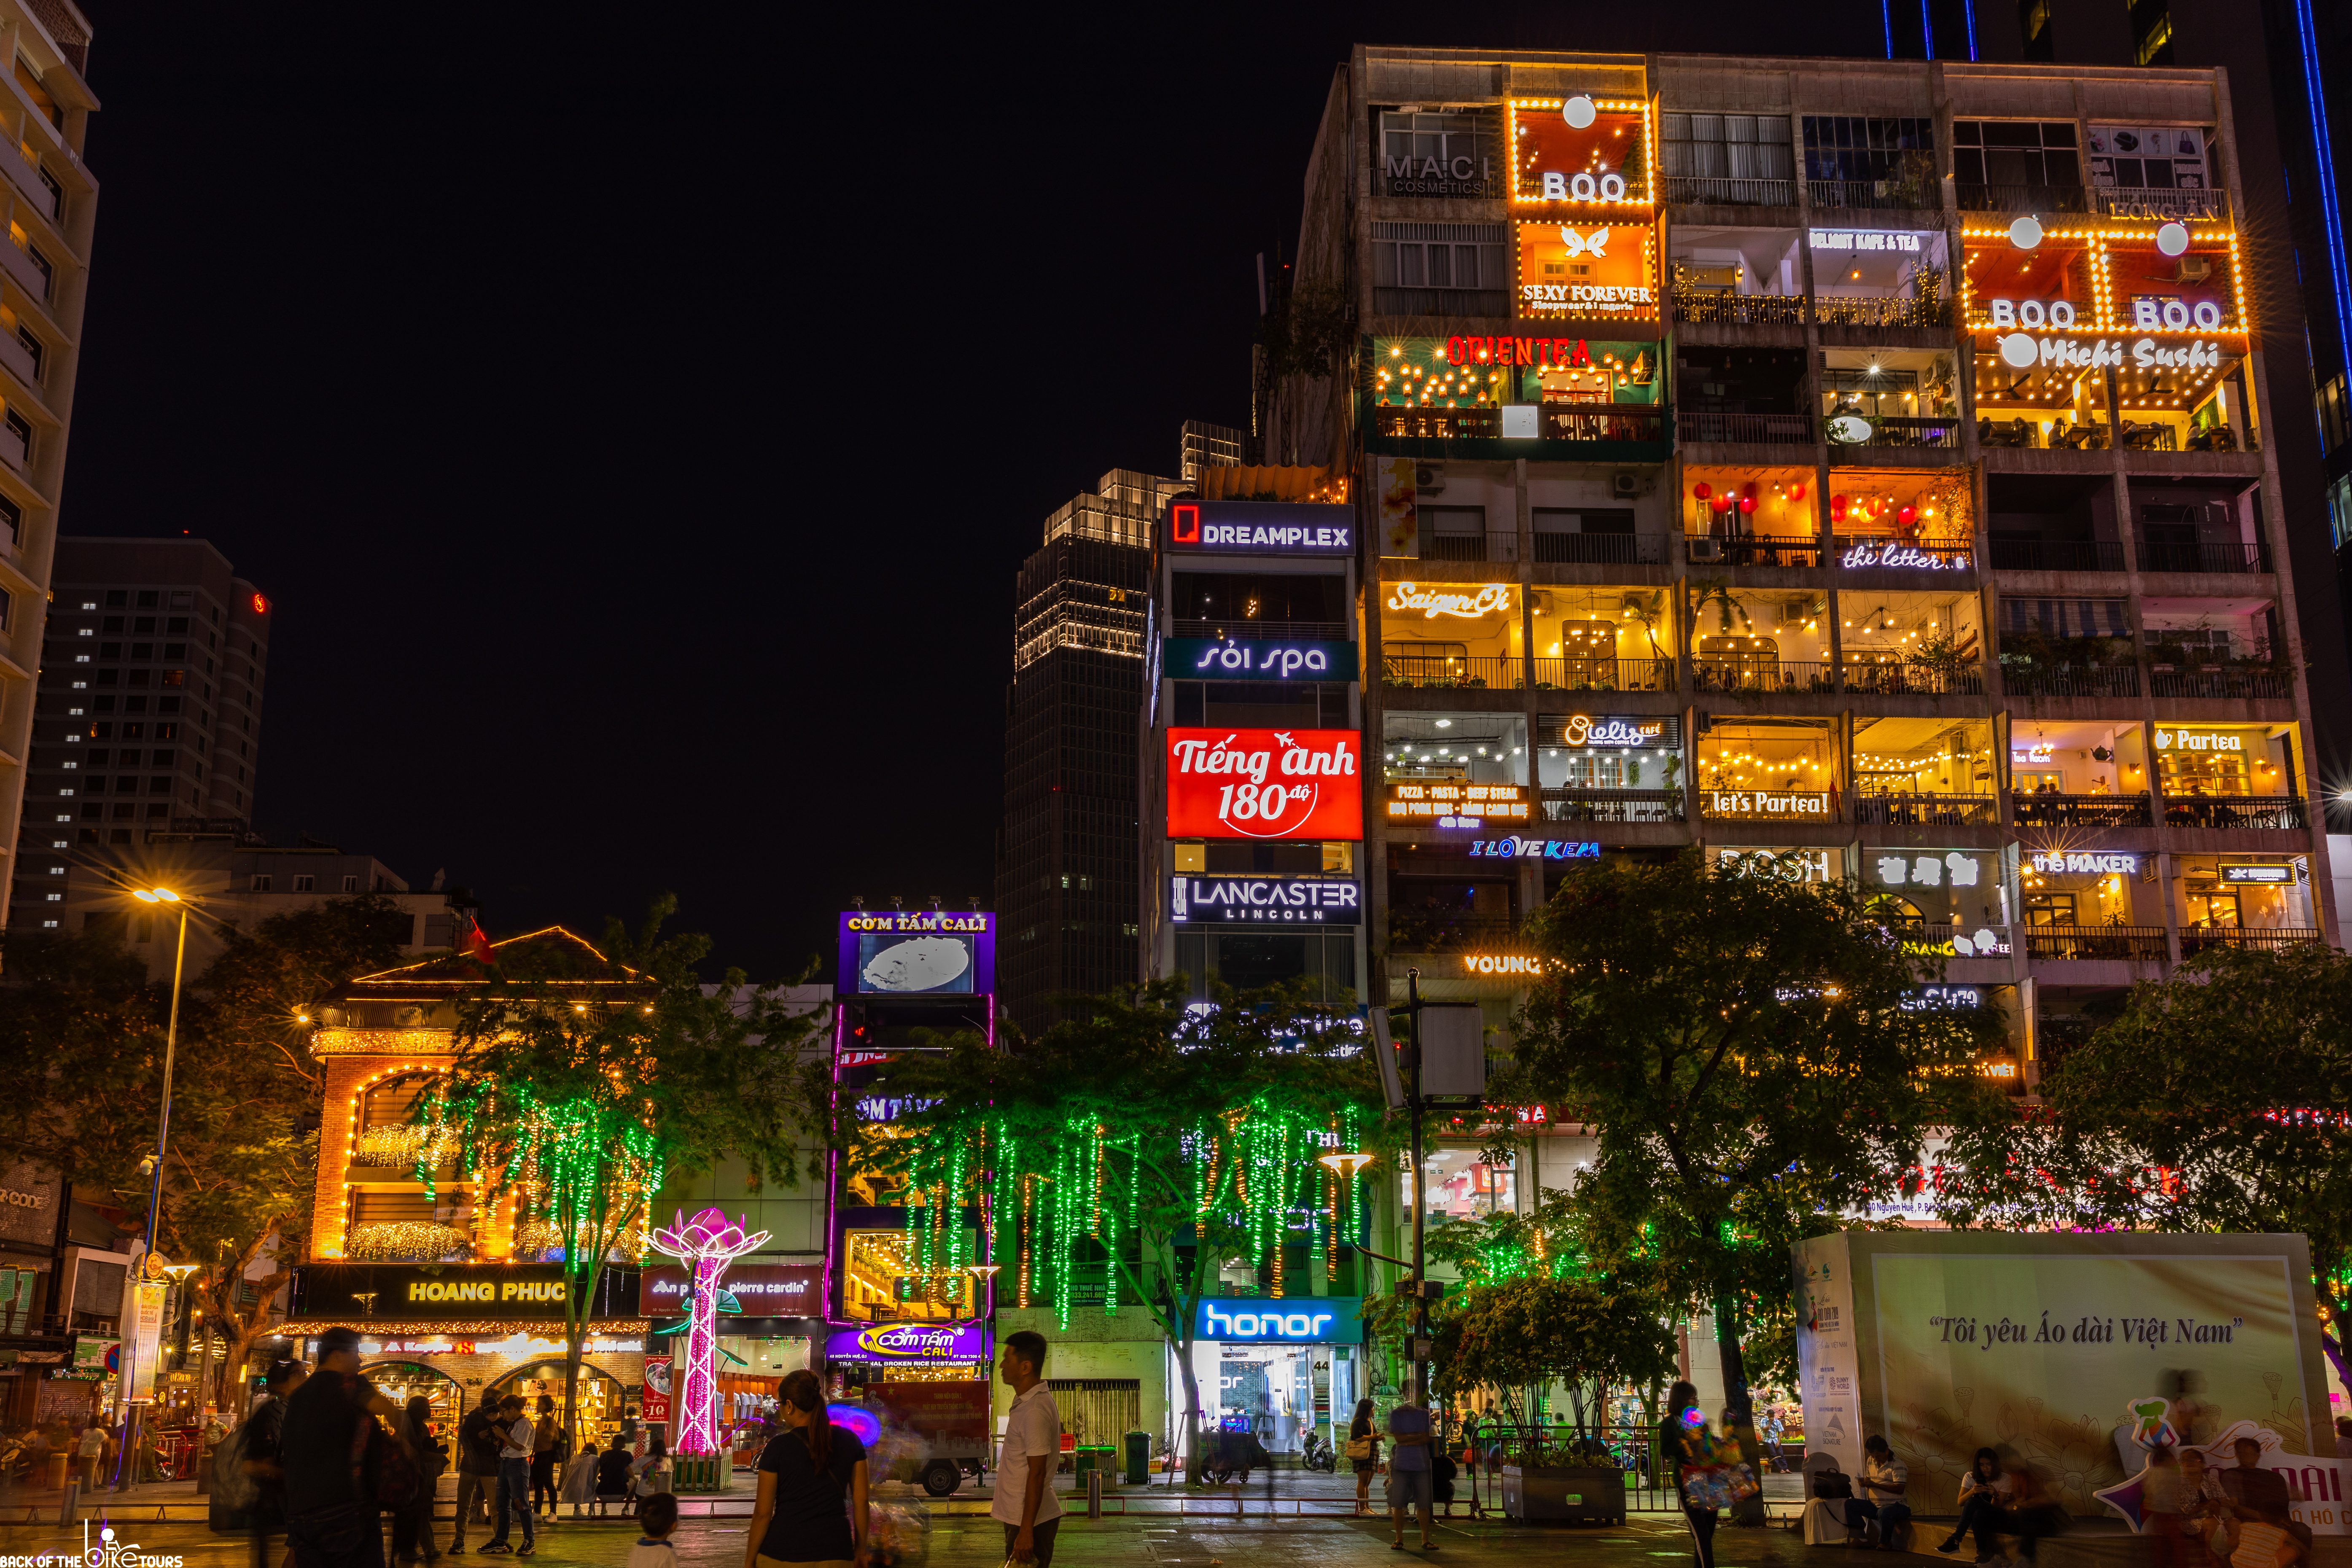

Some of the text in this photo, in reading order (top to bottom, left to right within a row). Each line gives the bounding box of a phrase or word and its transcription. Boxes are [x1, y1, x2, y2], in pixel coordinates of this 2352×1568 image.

[1387, 155, 1488, 180] MACI
[1394, 181, 1482, 194] COSMETICS
[1544, 172, 1625, 201] BOO
[2110, 194, 2218, 221] HỒNG ÂN
[1897, 235, 1919, 250] TEA
[1523, 285, 1652, 302] SEXY FOREVER
[1532, 301, 1585, 311] Sleepwear
[1992, 299, 2075, 328] BOO
[2135, 301, 2220, 331] BOO
[1447, 336, 1592, 367] ORIENTEA
[2040, 338, 2218, 368] Michi Sushi
[1203, 526, 1348, 546] DREAMPLEX
[1843, 546, 1877, 568] the
[1261, 649, 1325, 676] spa
[1640, 723, 1660, 734] CAFÉ
[2177, 730, 2240, 750] Partea
[1174, 734, 1270, 784] Tiếng
[1219, 784, 1311, 820] 180 độ
[1398, 786, 1518, 799] PIZZA PASTA BEEF STEAK
[1755, 792, 1828, 813] Partea!
[1408, 803, 1432, 814] PORK
[1469, 836, 1599, 858] I LOVE KEM
[2033, 854, 2135, 873] the MAKER
[1194, 882, 1356, 906] LANCASTER
[848, 912, 986, 931] CƠM TẤM CALI
[1226, 909, 1322, 919] LINCOLN
[1877, 1202, 1900, 1213] Nguyễn
[1918, 1203, 1923, 1211] P.
[409, 1282, 495, 1301] HOANG
[729, 1282, 804, 1295] pierre cardin
[1207, 1304, 1332, 1336] honor
[1981, 1317, 2028, 1350] yêu
[2033, 1310, 2066, 1343] Áo
[2072, 1315, 2114, 1344] dài
[2120, 1316, 2168, 1350] Việt
[920, 1329, 954, 1346] TẤM
[922, 1347, 953, 1356] CALI
[1314, 1361, 1329, 1371] 44
